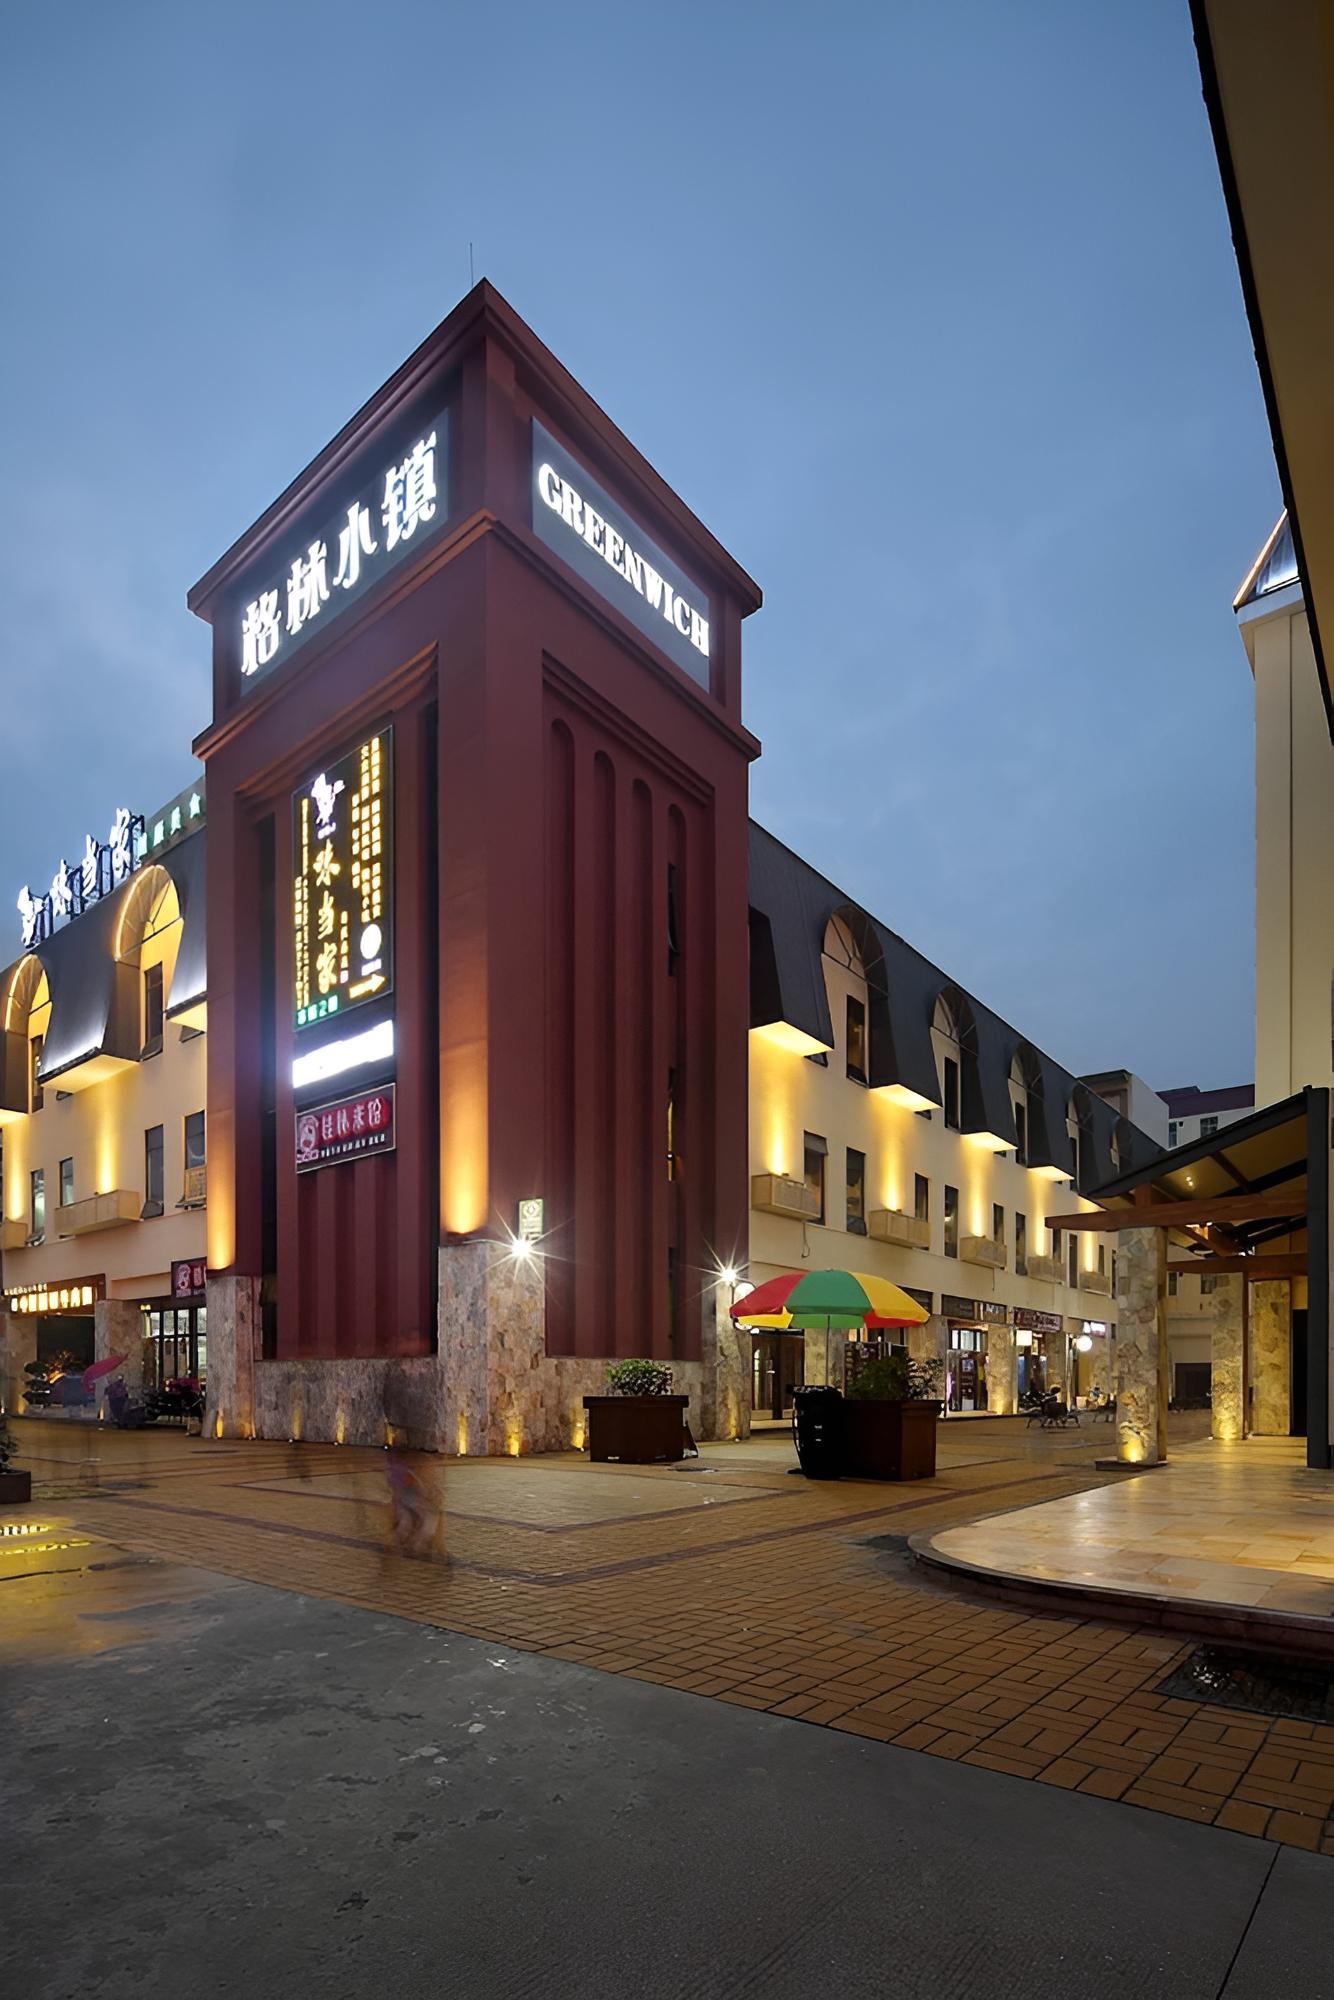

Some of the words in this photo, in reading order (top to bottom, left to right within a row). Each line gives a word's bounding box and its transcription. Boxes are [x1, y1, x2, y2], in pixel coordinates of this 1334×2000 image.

[241, 431, 438, 676] 格林小镇
[538, 463, 710, 657] GREENWICH
